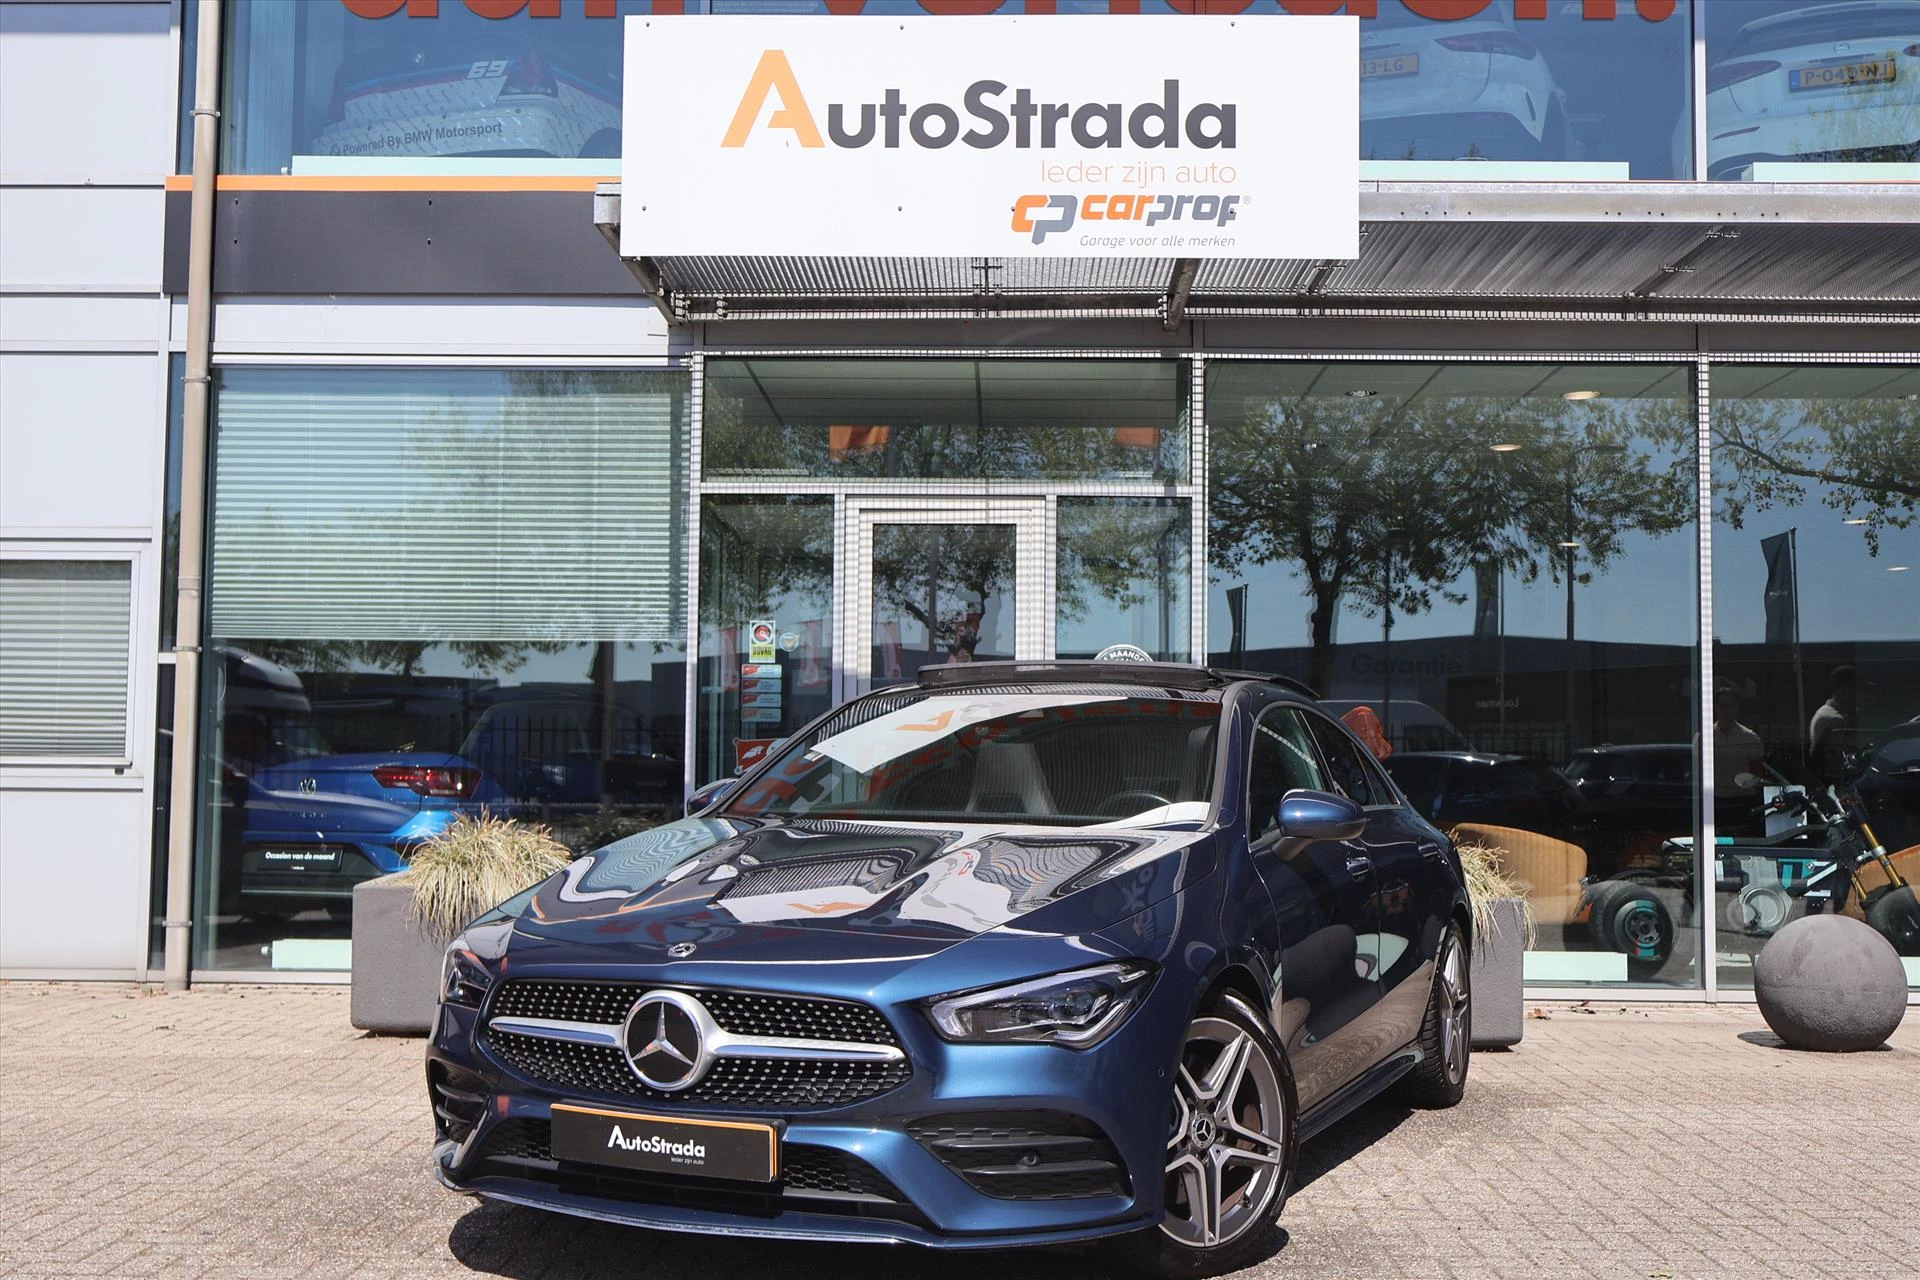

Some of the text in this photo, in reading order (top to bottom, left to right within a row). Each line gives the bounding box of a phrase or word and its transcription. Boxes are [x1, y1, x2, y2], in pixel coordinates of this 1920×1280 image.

[465, 59, 509, 80] 69
[1362, 58, 1404, 75] 13-LG
[720, 49, 1237, 150] AutoStrada
[343, 122, 503, 155] Powered By BMW Motorsport
[1041, 160, 1237, 189] Ieder zijn auto
[1080, 194, 1241, 228] carprof
[1080, 235, 1236, 249] Garage voor alle merken
[304, 851, 313, 860] de
[607, 1125, 705, 1156] AutoStrada
